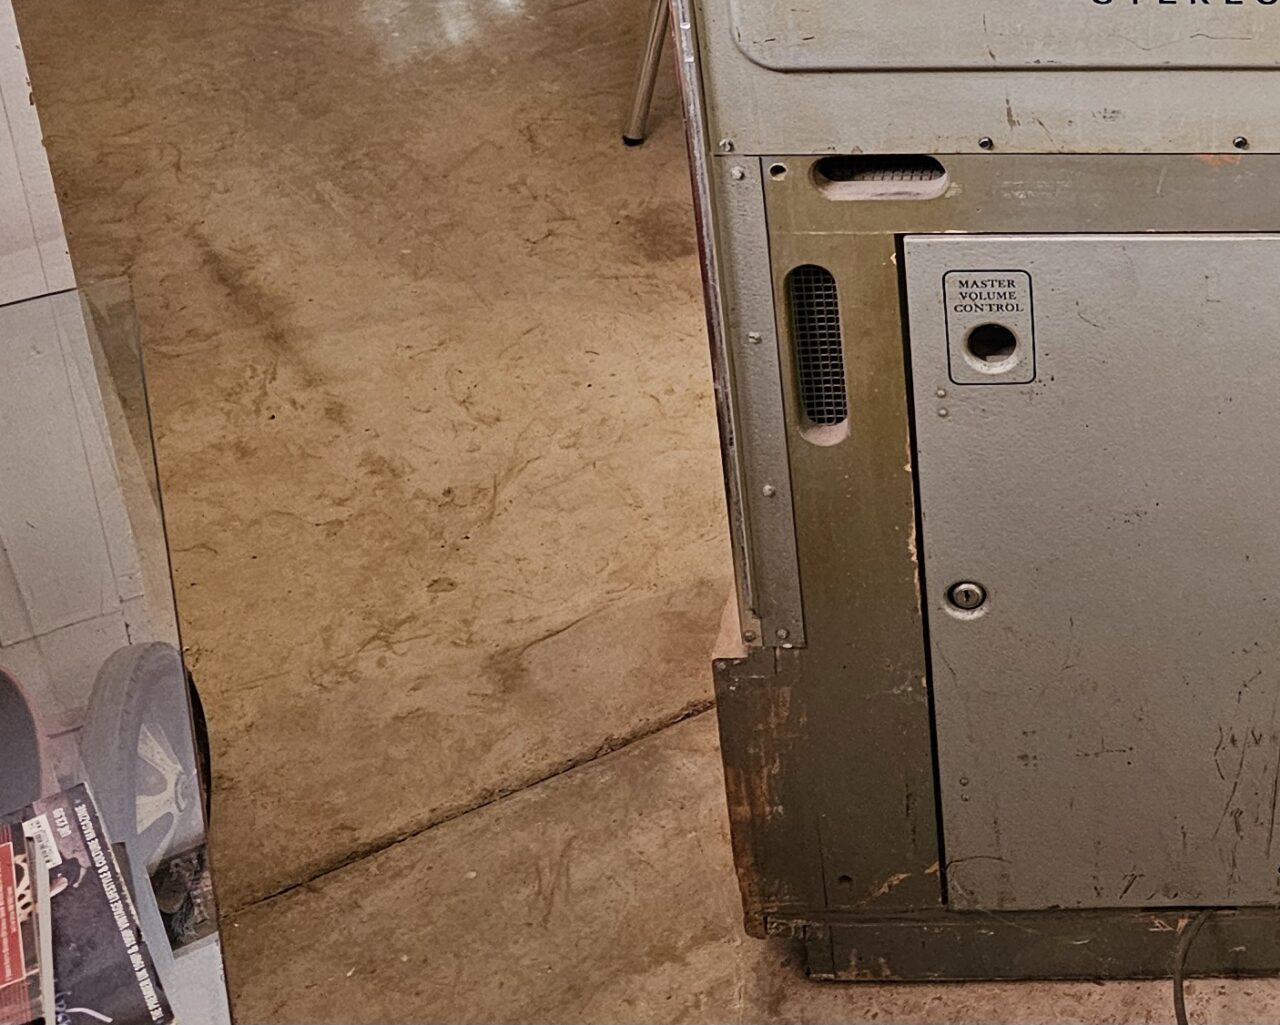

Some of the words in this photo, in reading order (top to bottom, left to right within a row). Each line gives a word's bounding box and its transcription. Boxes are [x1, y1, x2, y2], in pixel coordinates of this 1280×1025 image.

[958, 279, 1016, 289] MASTER
[959, 291, 1017, 301] VOLUME
[954, 303, 1024, 313] CONTROL
[73, 804, 97, 841] MAGAZINE
[86, 838, 107, 868] CULTURE
[99, 871, 121, 903] LIFESTYLE
[108, 899, 130, 931] VINTAGE
